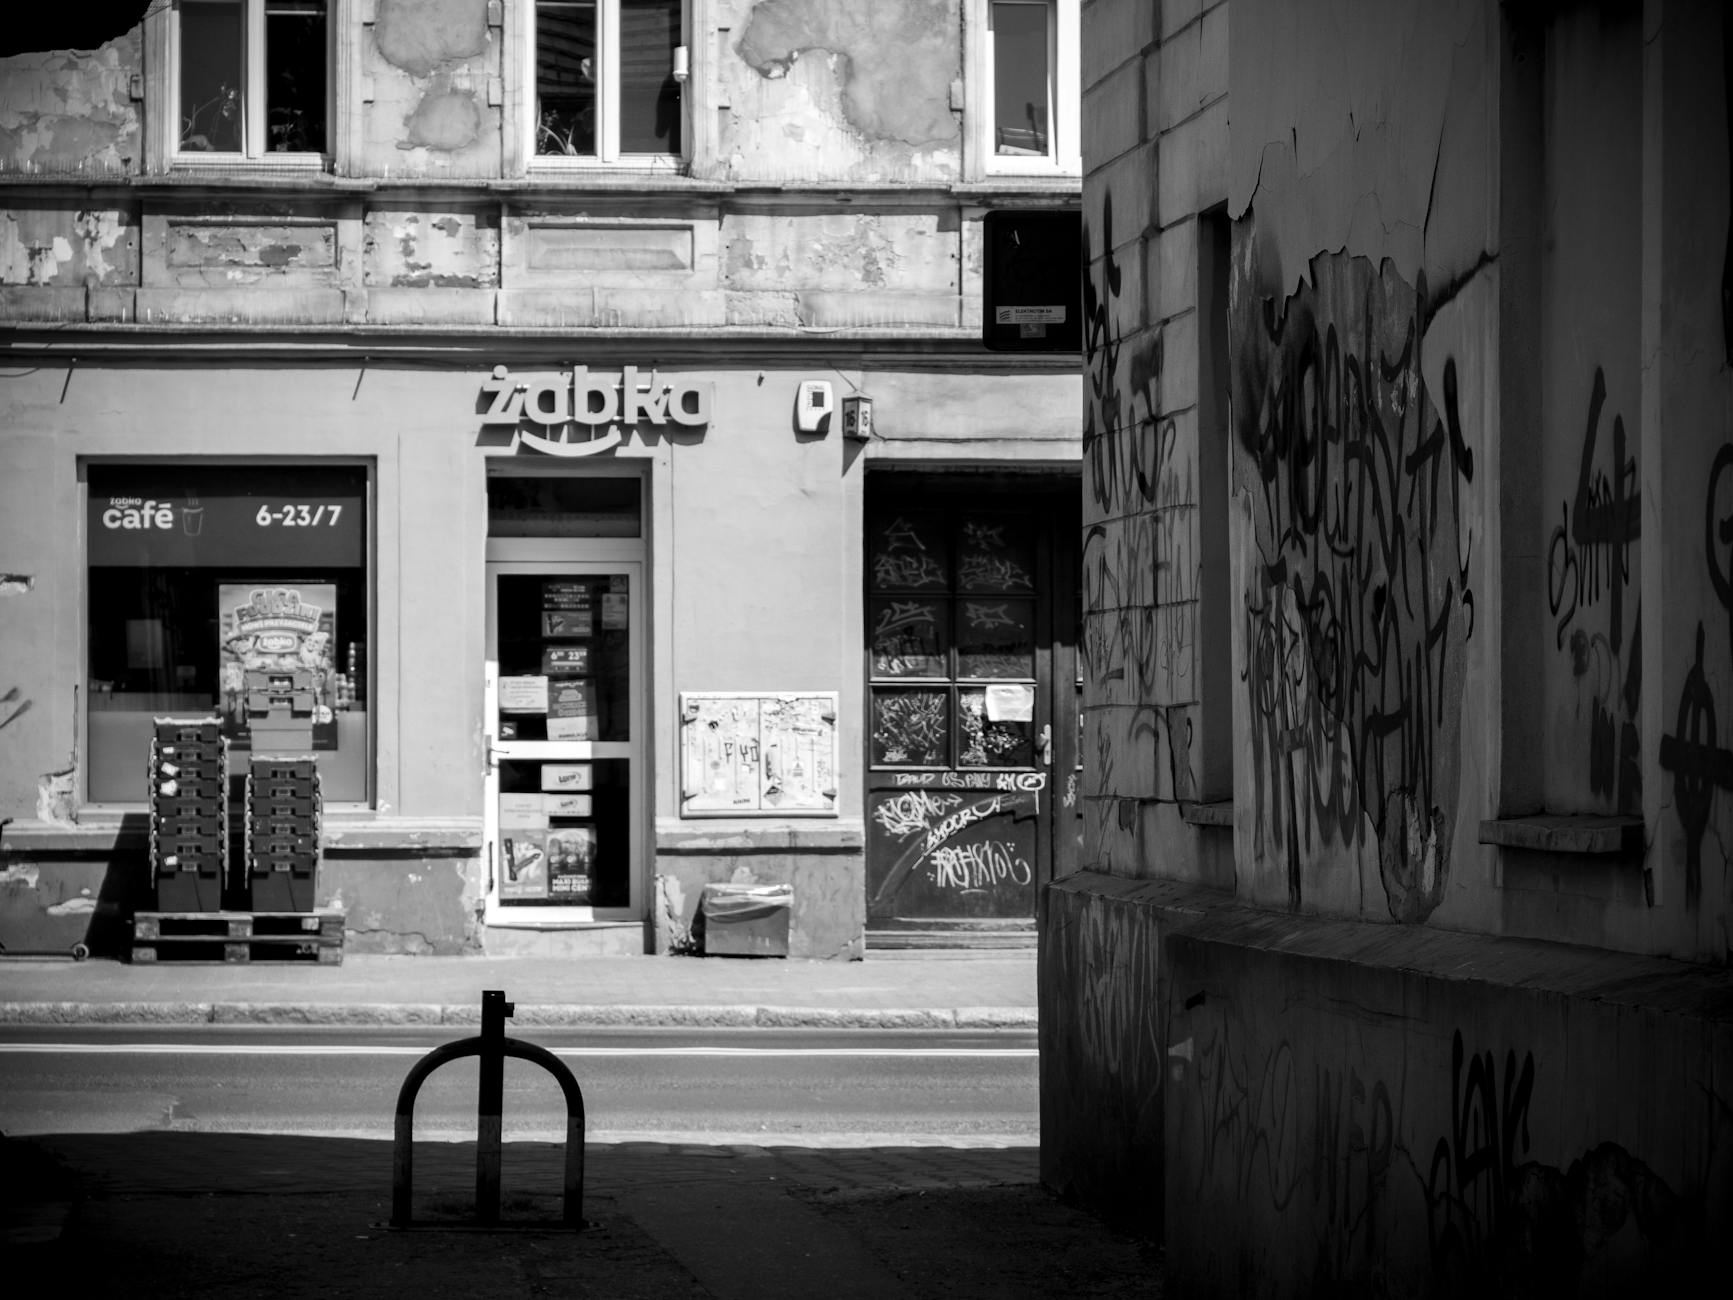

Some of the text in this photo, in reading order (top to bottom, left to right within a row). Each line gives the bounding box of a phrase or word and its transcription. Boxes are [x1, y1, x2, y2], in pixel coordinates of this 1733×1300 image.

[481, 364, 709, 426] żabka
[102, 501, 174, 530] café
[255, 505, 342, 527] 6-23/7
